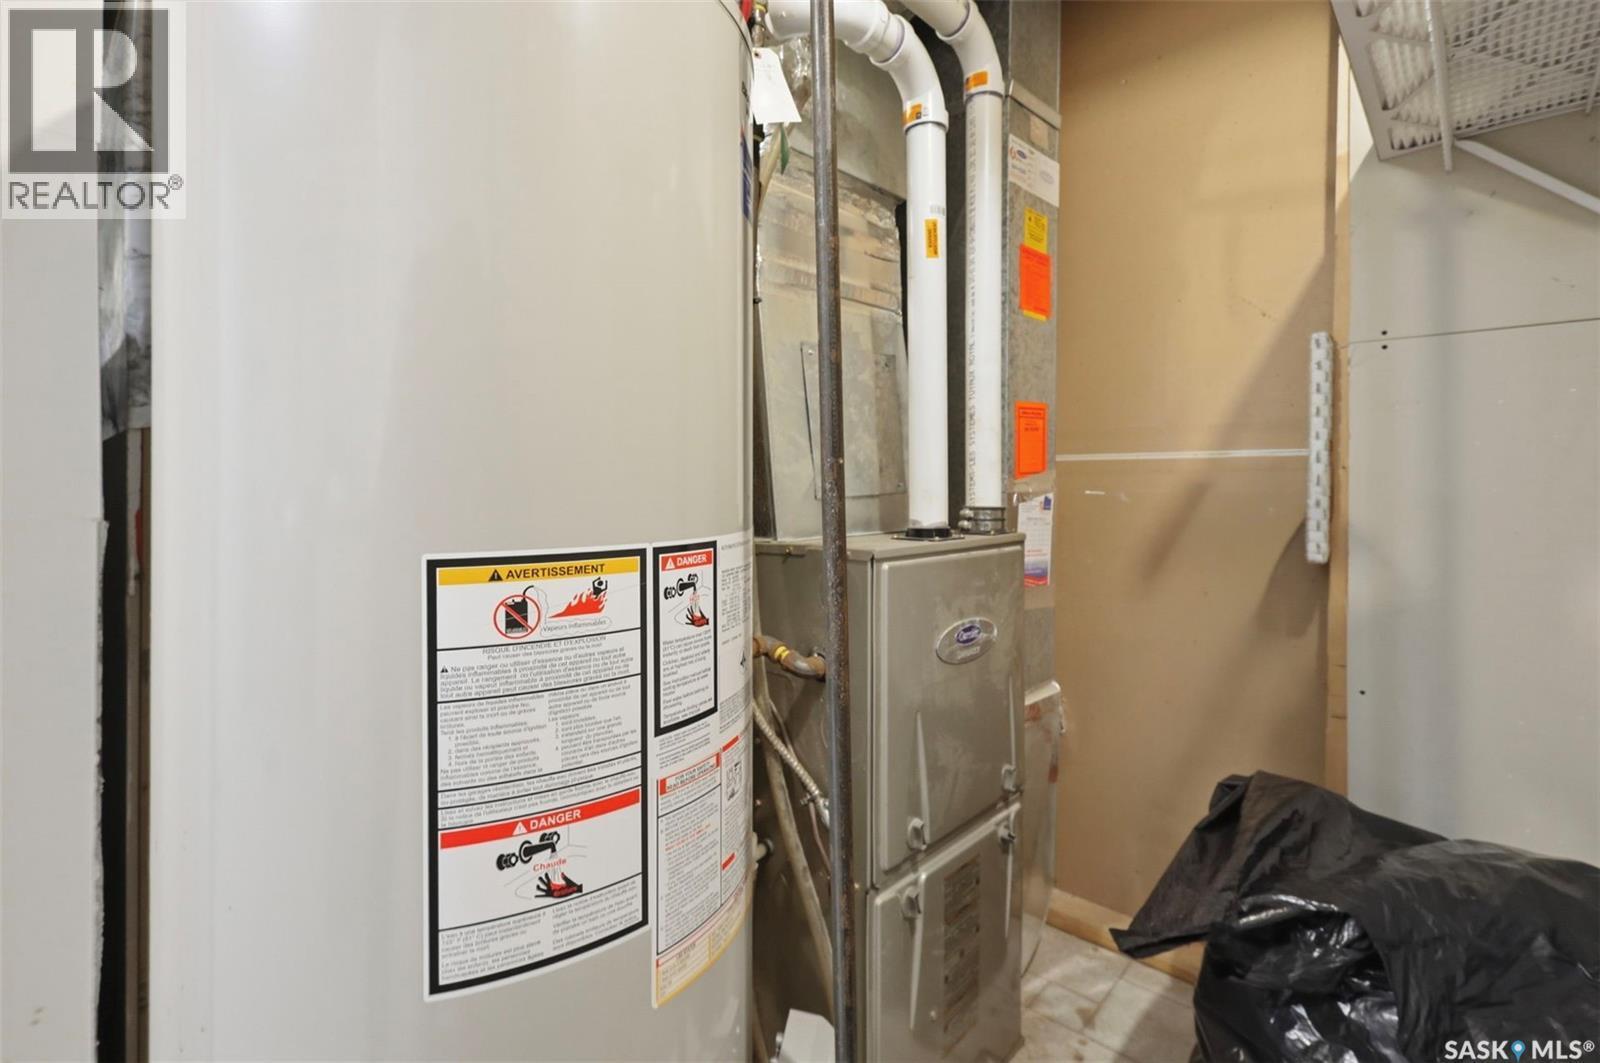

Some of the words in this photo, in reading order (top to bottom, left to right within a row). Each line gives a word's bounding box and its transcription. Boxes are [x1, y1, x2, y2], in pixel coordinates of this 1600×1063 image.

[676, 554, 708, 567] DANGER
[506, 563, 606, 580] AVERTISSEMENT
[543, 624, 567, 633] Vapeurs
[568, 620, 606, 630] inflammables
[530, 809, 581, 830] DANGER
[533, 858, 567, 872] Chaude
